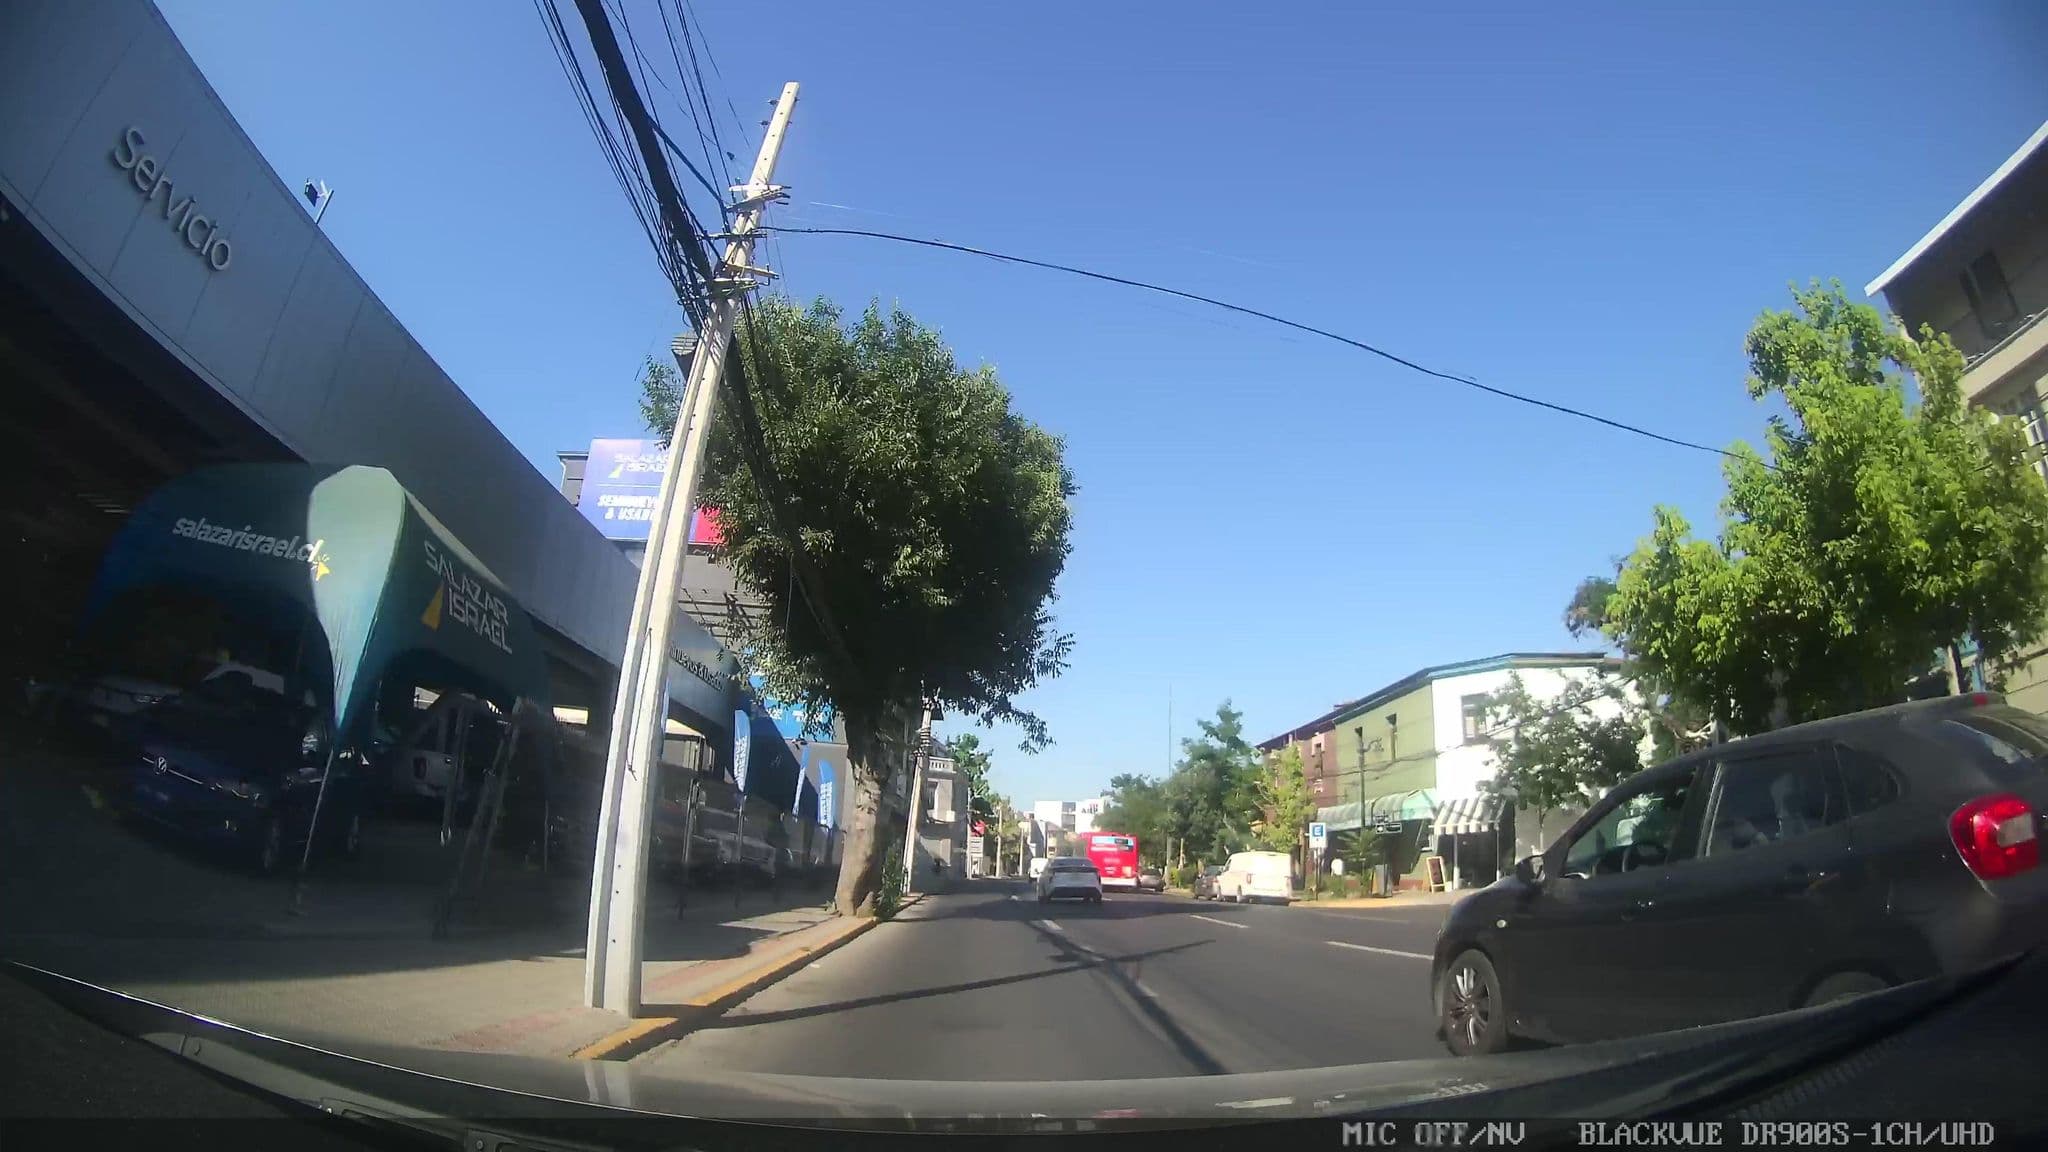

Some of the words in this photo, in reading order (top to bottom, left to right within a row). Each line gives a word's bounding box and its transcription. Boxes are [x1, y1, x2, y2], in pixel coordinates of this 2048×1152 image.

[114, 127, 232, 270] Servicio
[171, 516, 325, 563] salazarisrael.cl
[423, 539, 509, 625] SALAZAR
[448, 587, 513, 655] ISRAEL
